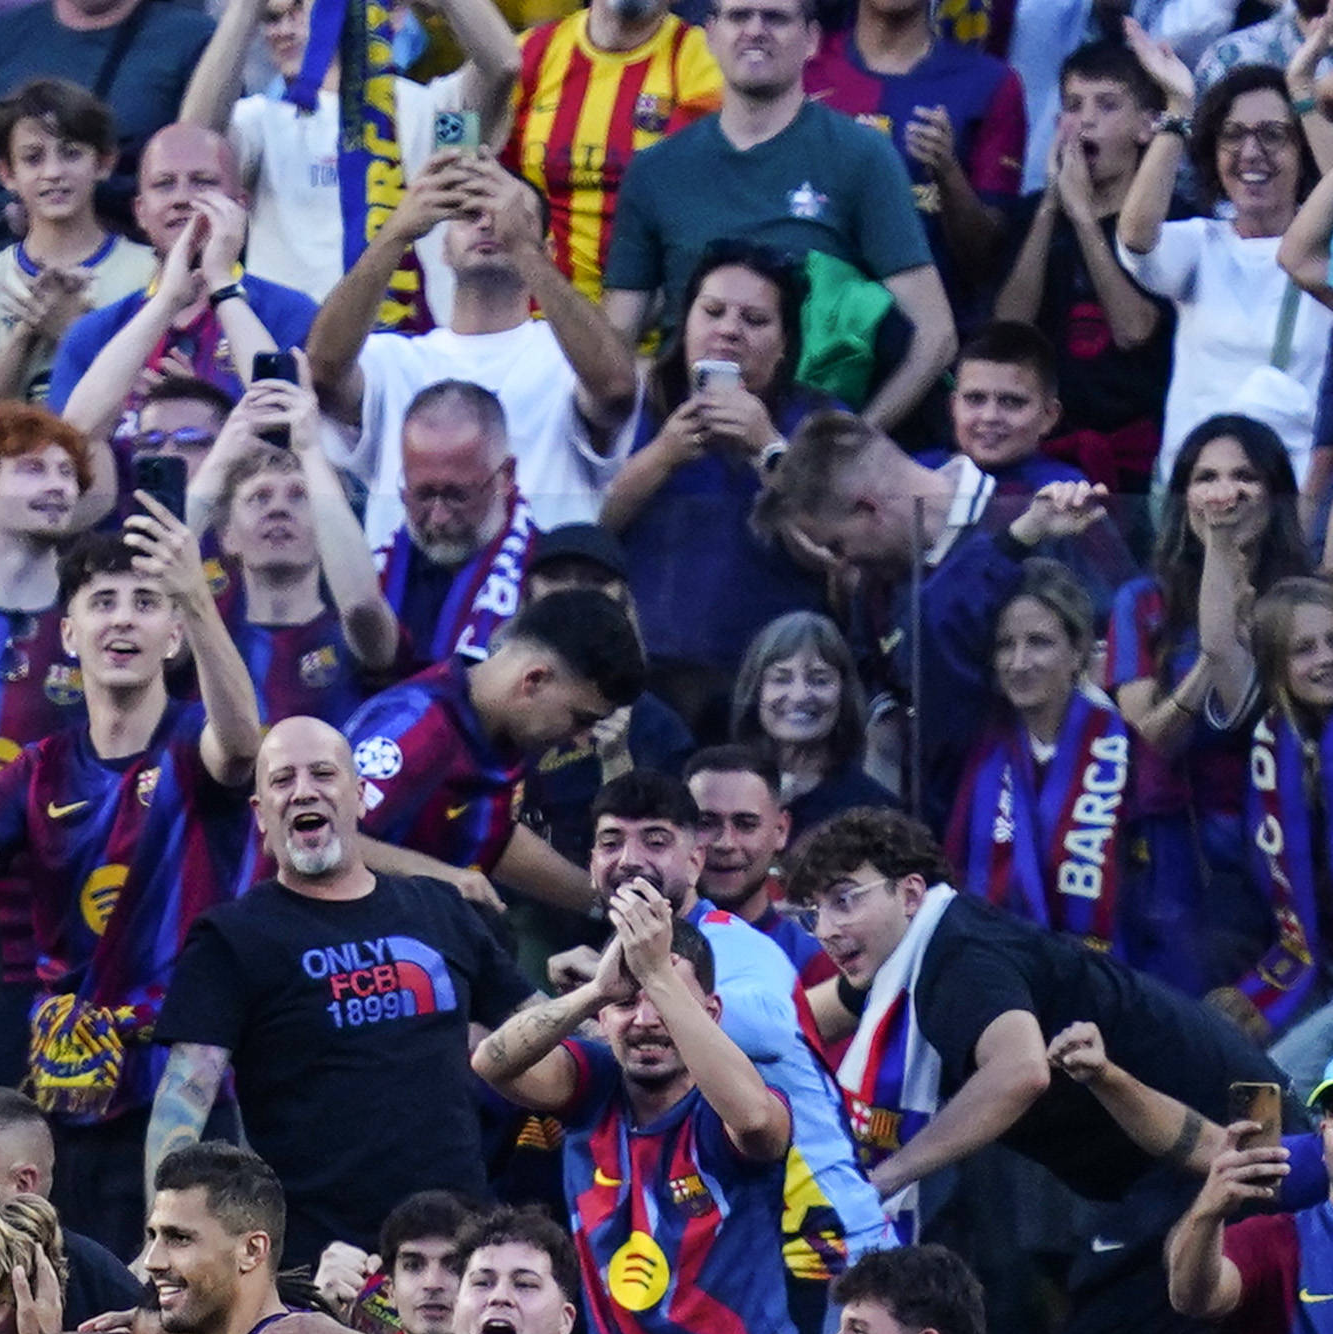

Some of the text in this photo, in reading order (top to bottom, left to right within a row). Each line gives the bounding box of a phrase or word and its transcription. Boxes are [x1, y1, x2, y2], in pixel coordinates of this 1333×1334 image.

[302, 938, 386, 979] ONLY
[330, 964, 399, 999] FCB
[327, 991, 401, 1028] 1899
